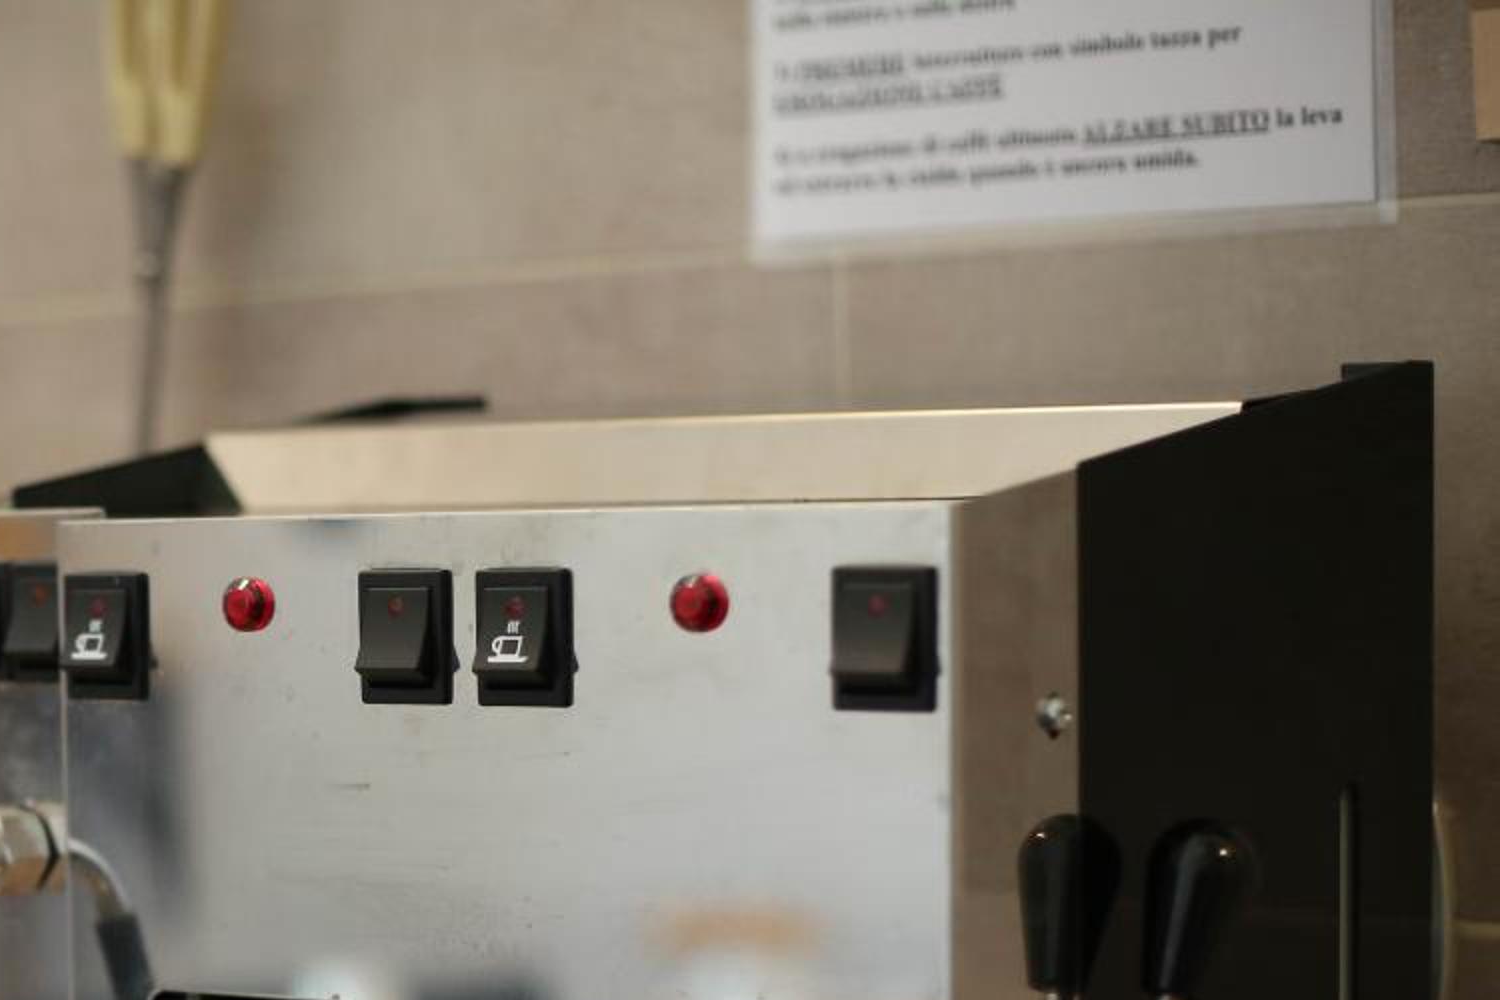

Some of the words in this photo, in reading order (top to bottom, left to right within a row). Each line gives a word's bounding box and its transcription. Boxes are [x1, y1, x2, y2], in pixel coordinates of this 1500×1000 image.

[1208, 26, 1242, 52] per
[1181, 109, 1269, 136] SUBITO
[1275, 108, 1295, 128] la
[1301, 105, 1344, 126] leva
